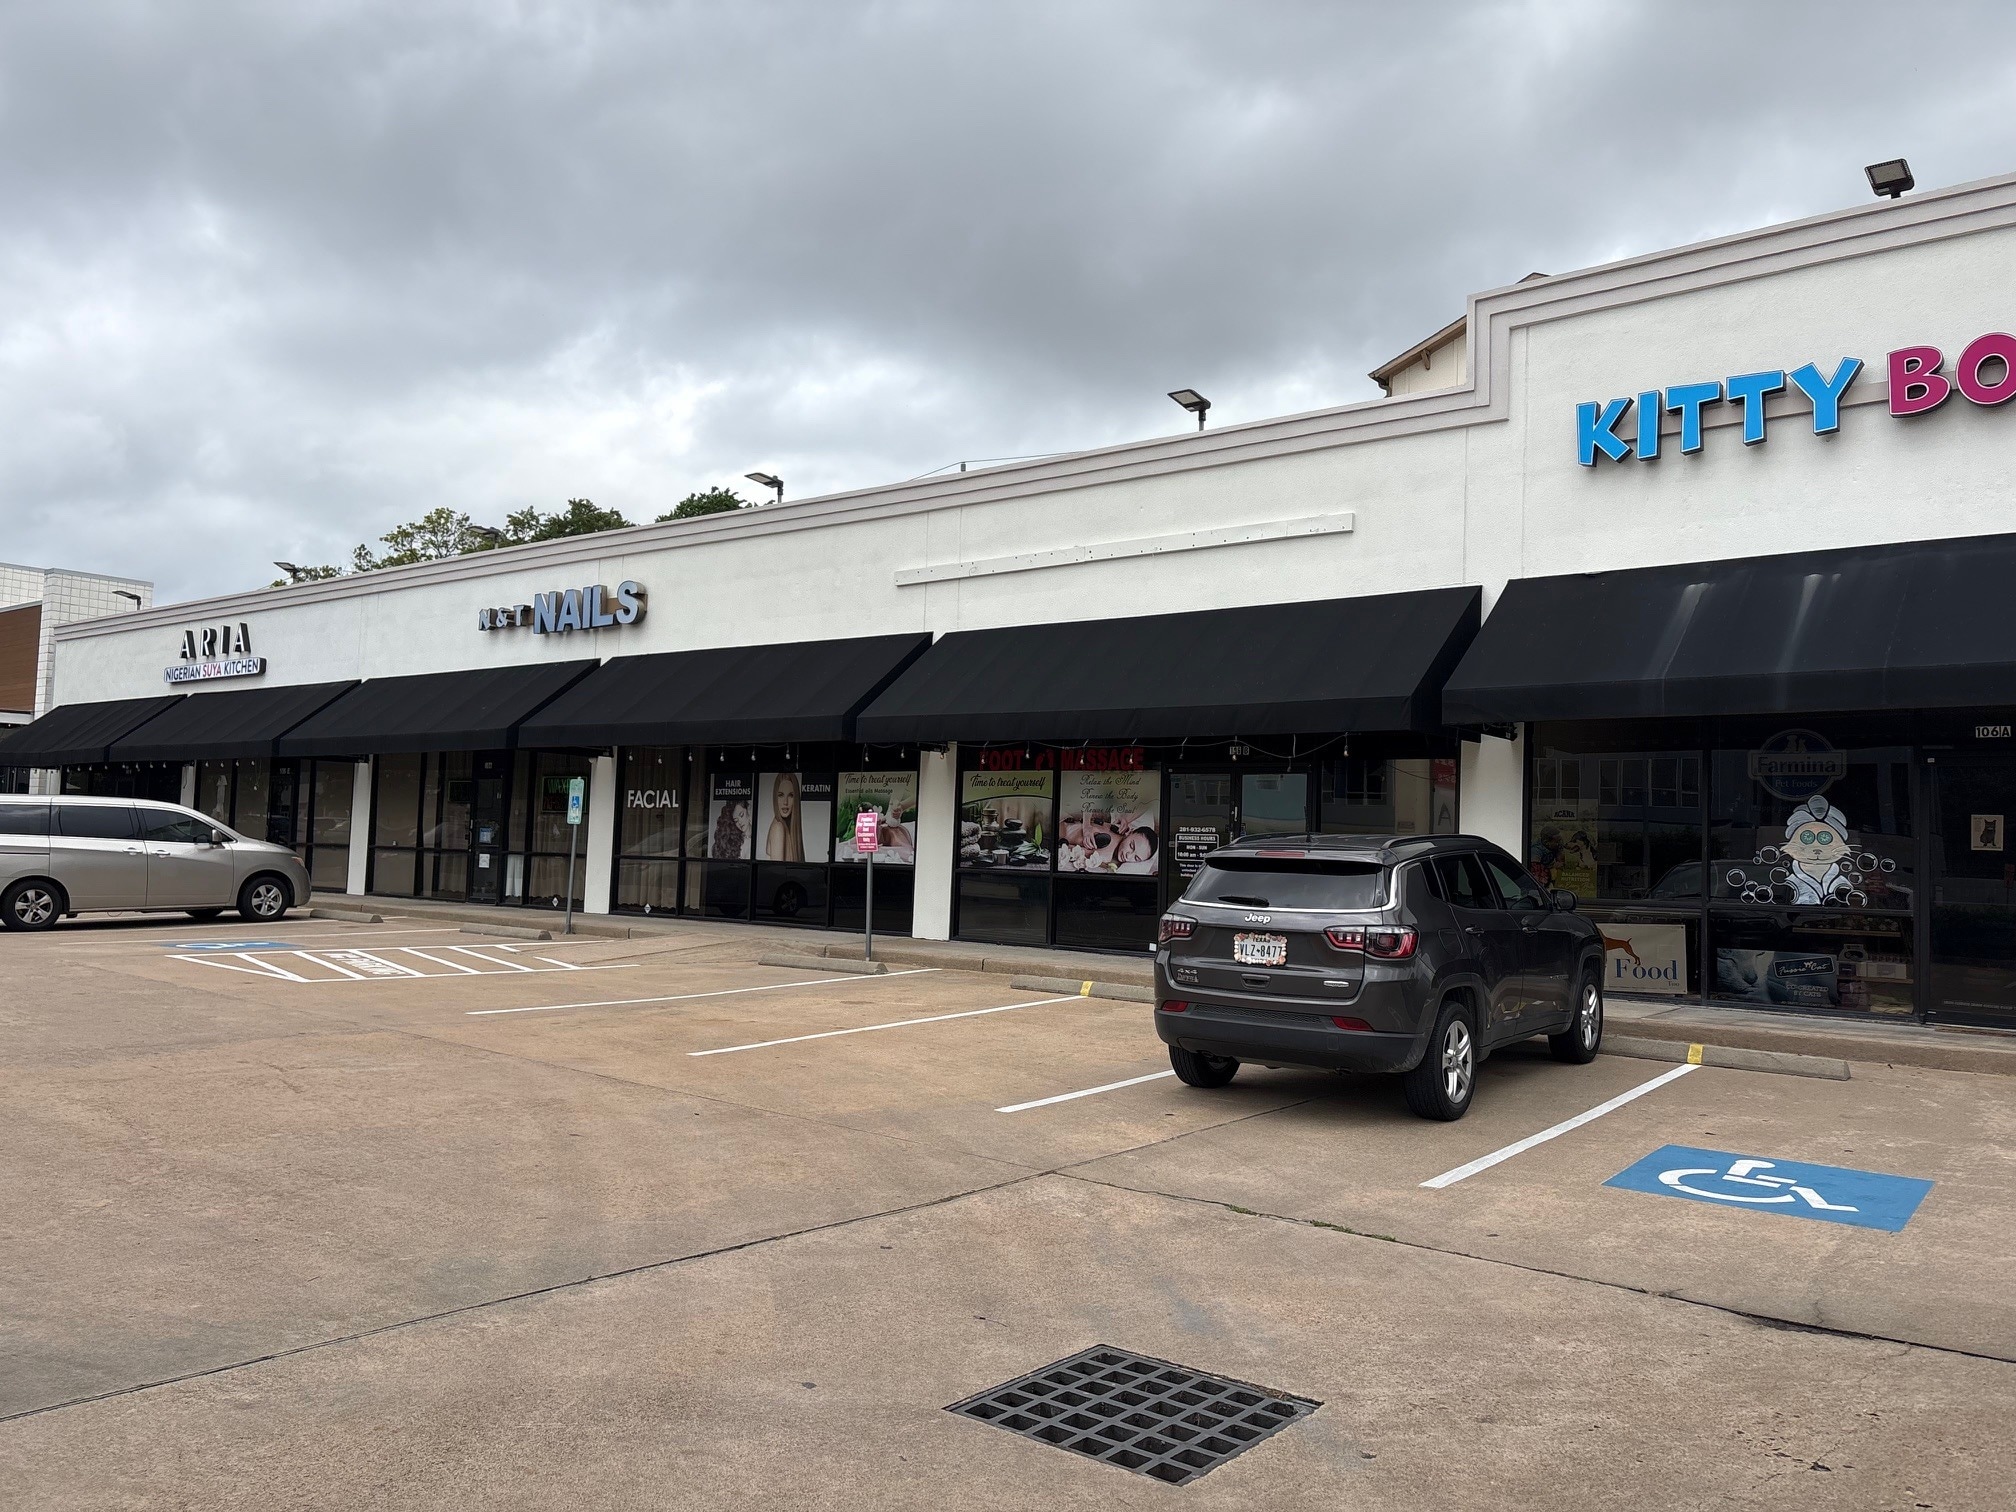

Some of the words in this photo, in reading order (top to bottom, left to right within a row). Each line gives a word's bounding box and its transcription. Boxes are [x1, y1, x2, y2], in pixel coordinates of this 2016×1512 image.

[1576, 357, 1864, 467] KITTY
[478, 608, 496, 631] N
[496, 607, 513, 628] &
[513, 604, 531, 627] T
[533, 580, 647, 634] NAILS
[179, 622, 251, 659] ARIA
[165, 665, 201, 682] NIGERIAN
[202, 662, 222, 677] SUYA
[223, 658, 259, 675] KITCHEN
[979, 749, 1024, 771] FOOT
[1060, 748, 1144, 771] MASSAGE
[1757, 756, 1836, 773] Farmina
[715, 787, 751, 796] EXTENSIONS
[725, 780, 741, 788] HAIR
[801, 784, 831, 792] KERATIN
[970, 774, 988, 787] Time
[988, 777, 996, 786] to
[997, 776, 1016, 787] treat
[1013, 776, 1046, 791] yourself
[627, 789, 679, 808] FACIAL
[1245, 913, 1271, 925] Jeep
[1616, 958, 1678, 980] Food
